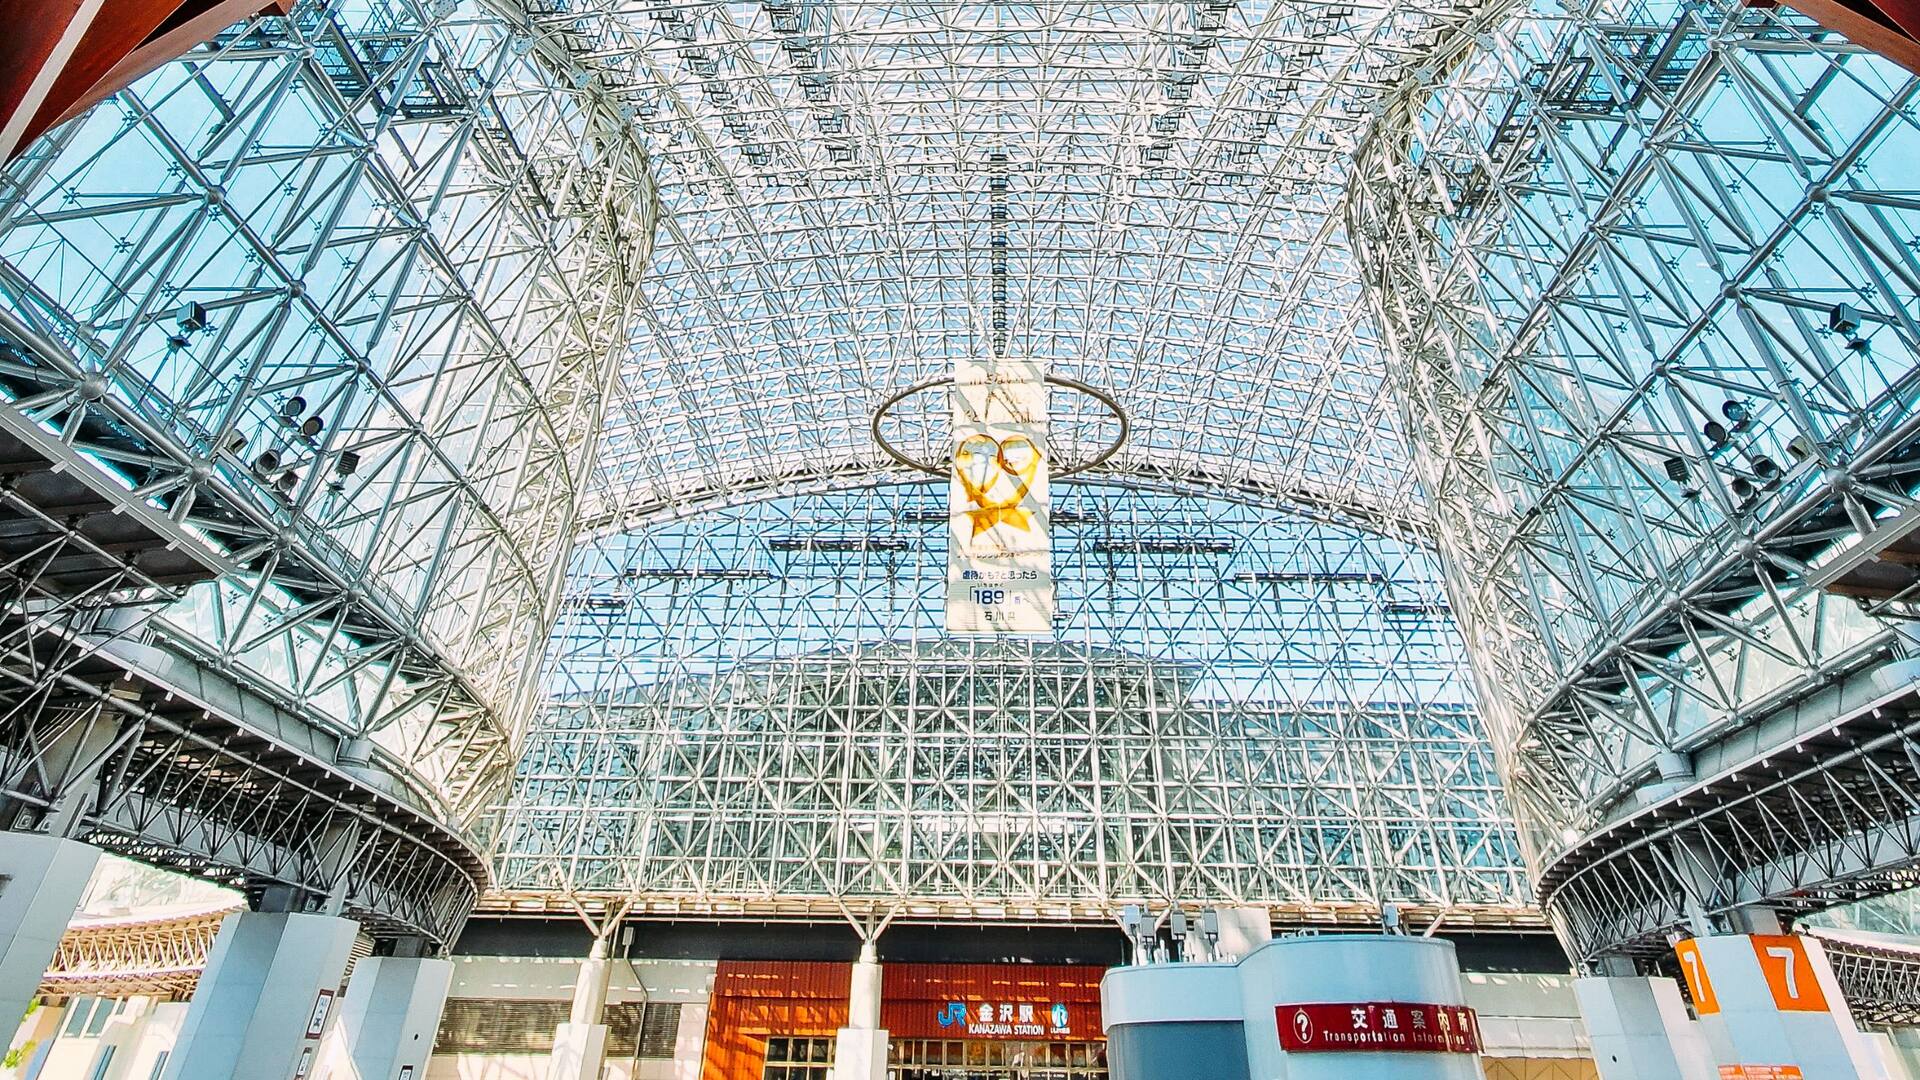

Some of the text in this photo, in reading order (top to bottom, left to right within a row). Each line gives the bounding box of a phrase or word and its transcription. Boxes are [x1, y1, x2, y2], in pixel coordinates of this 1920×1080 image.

[1682, 950, 1706, 1003] 7
[1766, 946, 1799, 999] 7
[937, 1002, 967, 1028] JR
[979, 1003, 1034, 1022] 金沢駅
[1350, 1008, 1469, 1033] 交通案内所
[968, 1023, 1012, 1035] KANAZAWA
[1014, 1025, 1044, 1035] STATION
[1323, 1029, 1405, 1043] Transportation
